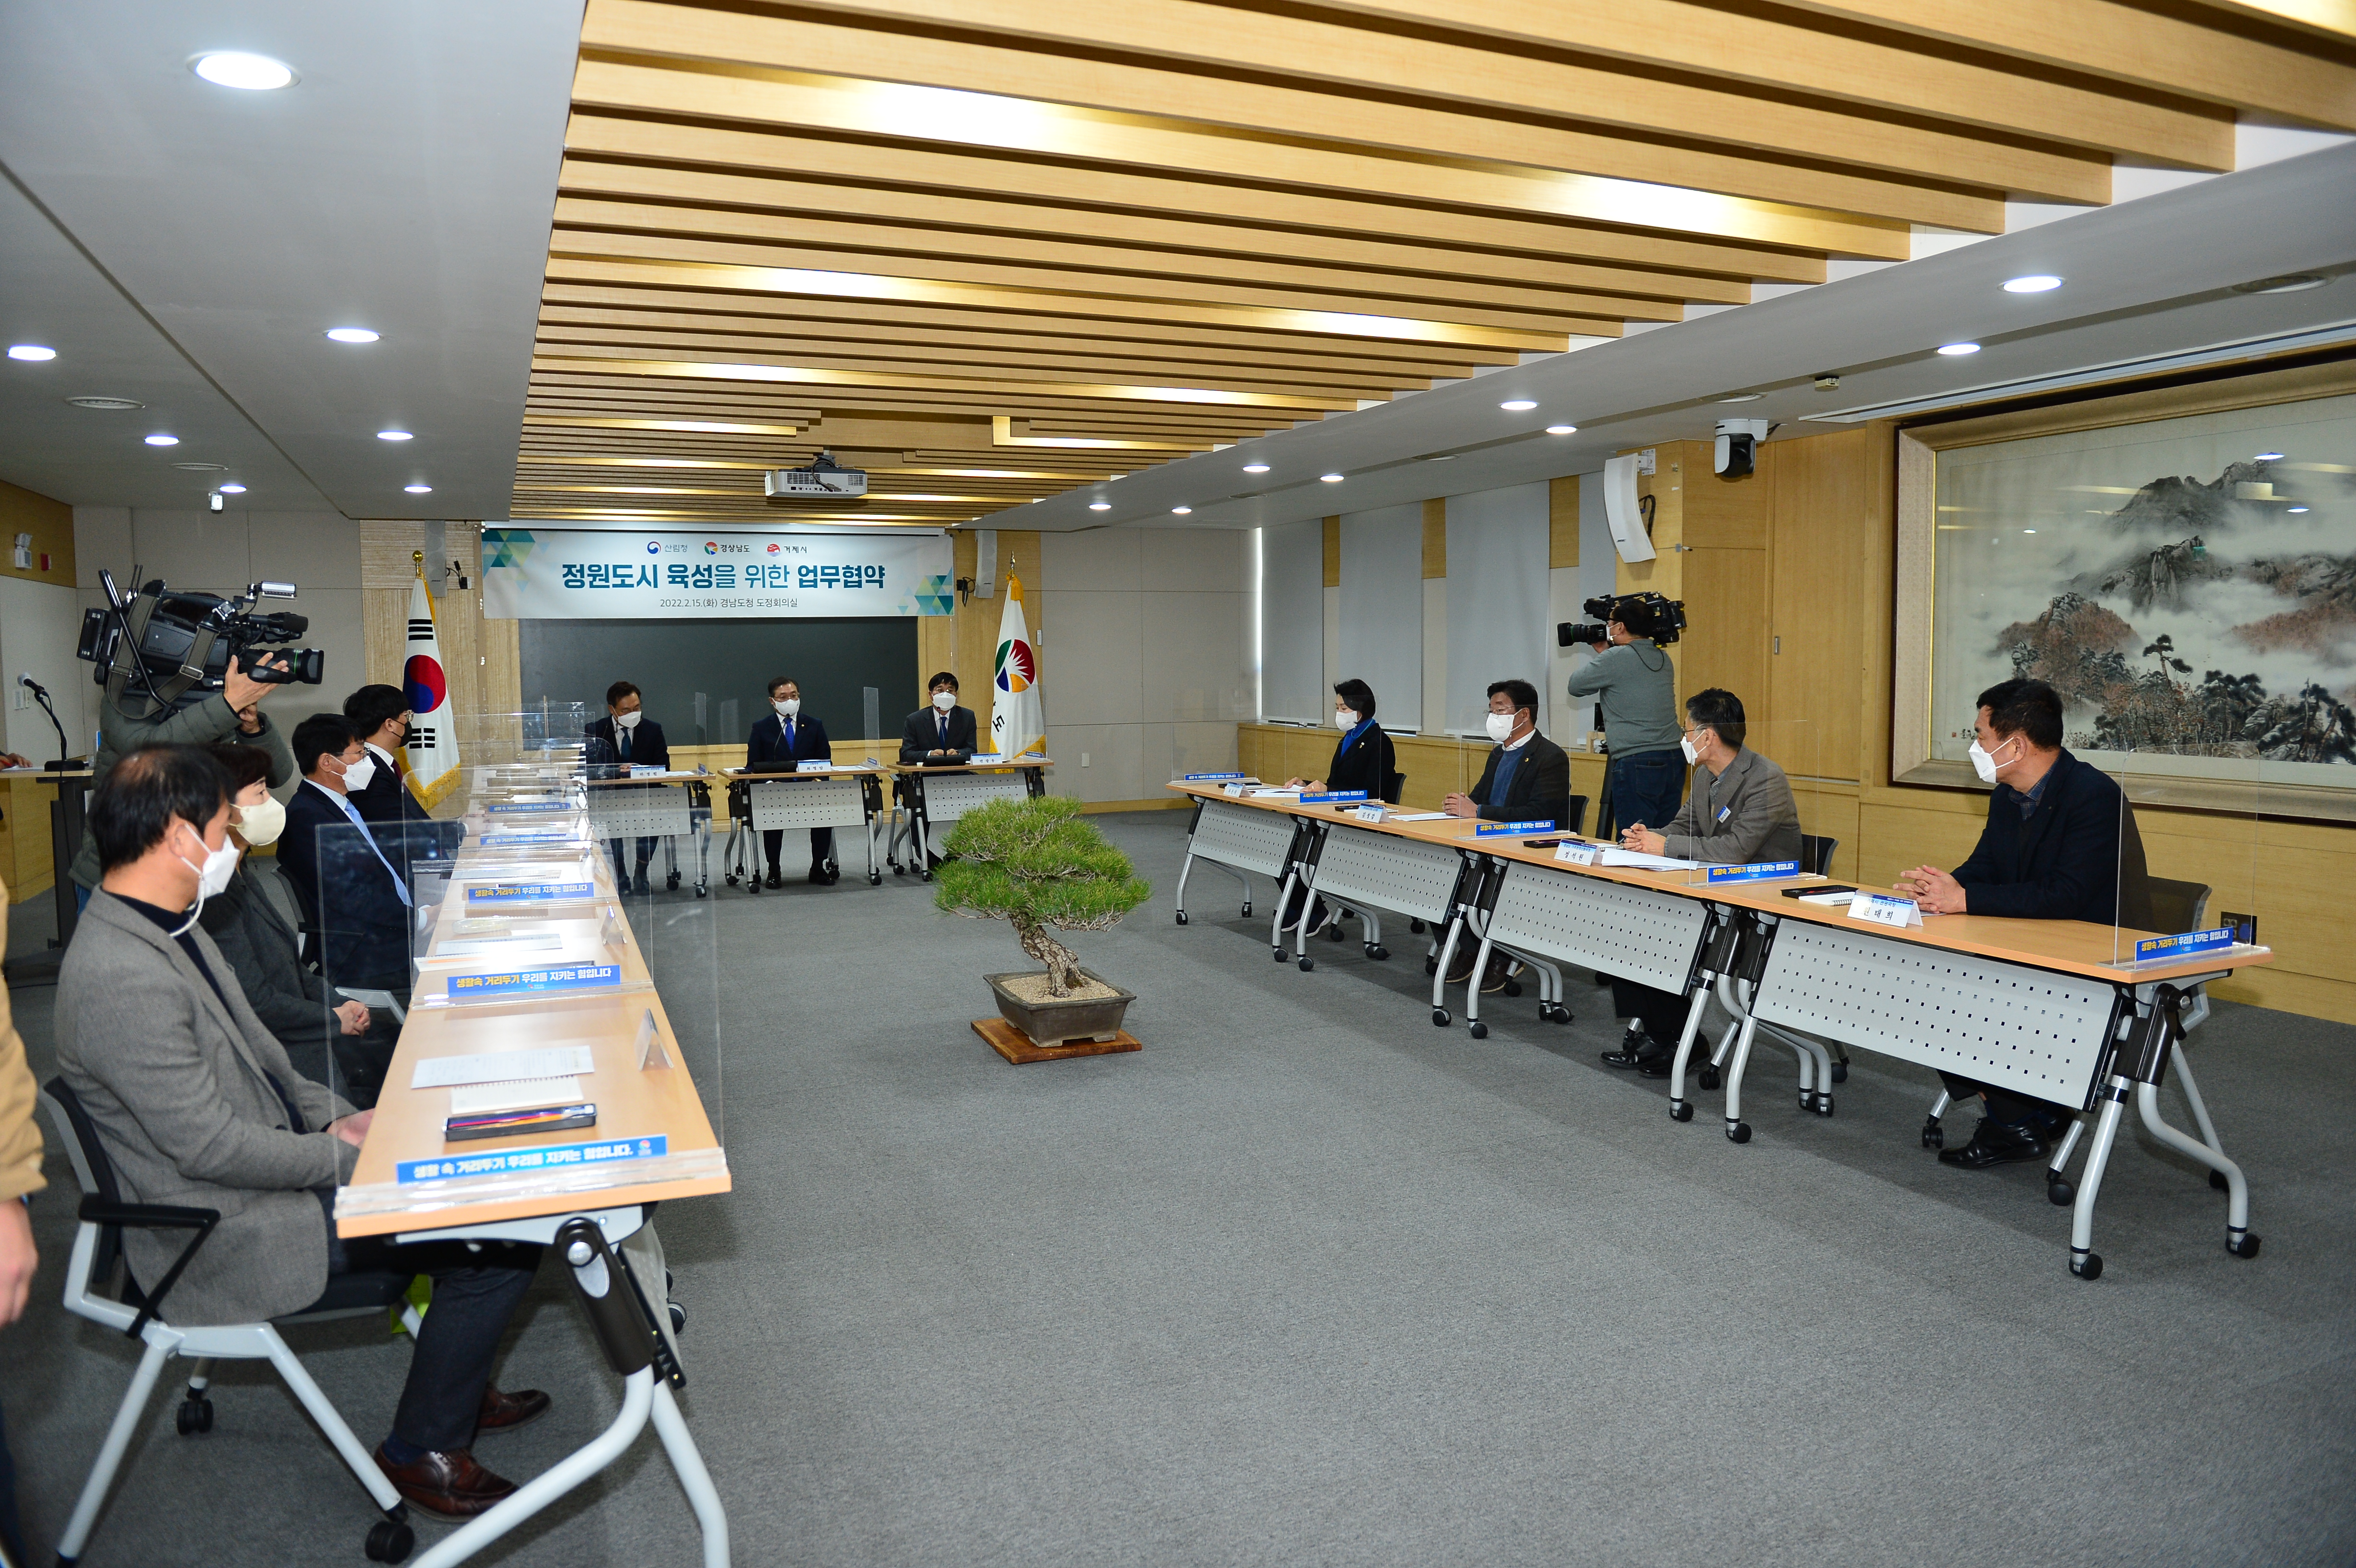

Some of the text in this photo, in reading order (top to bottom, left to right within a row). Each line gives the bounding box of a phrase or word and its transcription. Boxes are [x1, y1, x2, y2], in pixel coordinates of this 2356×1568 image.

[720, 544, 750, 553] 경상남도
[562, 564, 885, 589] 정원도시 육성을 위한 업무협약
[660, 598, 798, 608] 2022.2.15.(화) 경남도청 도정회의실
[1564, 851, 1584, 861] 정석원
[1776, 863, 1794, 871] 힘입니다
[475, 889, 494, 897] 생활속
[495, 888, 521, 896] 거리두기
[562, 884, 588, 893] 힘입니다
[1863, 907, 1894, 921] 원태희
[2141, 941, 2157, 951] 생활속
[2158, 937, 2178, 949] 거리두기
[2178, 935, 2193, 946] 우리를
[2194, 933, 2209, 943] 지키는
[2210, 930, 2229, 941] 힘입니다
[456, 968, 612, 988] 생활속 거리두기 우리를 지키는 힘입니다
[414, 1163, 439, 1179] 생활
[441, 1162, 456, 1175] 속
[456, 1156, 507, 1173] 거리두기
[507, 1152, 544, 1168] 우리를
[545, 1149, 582, 1164] 지키는
